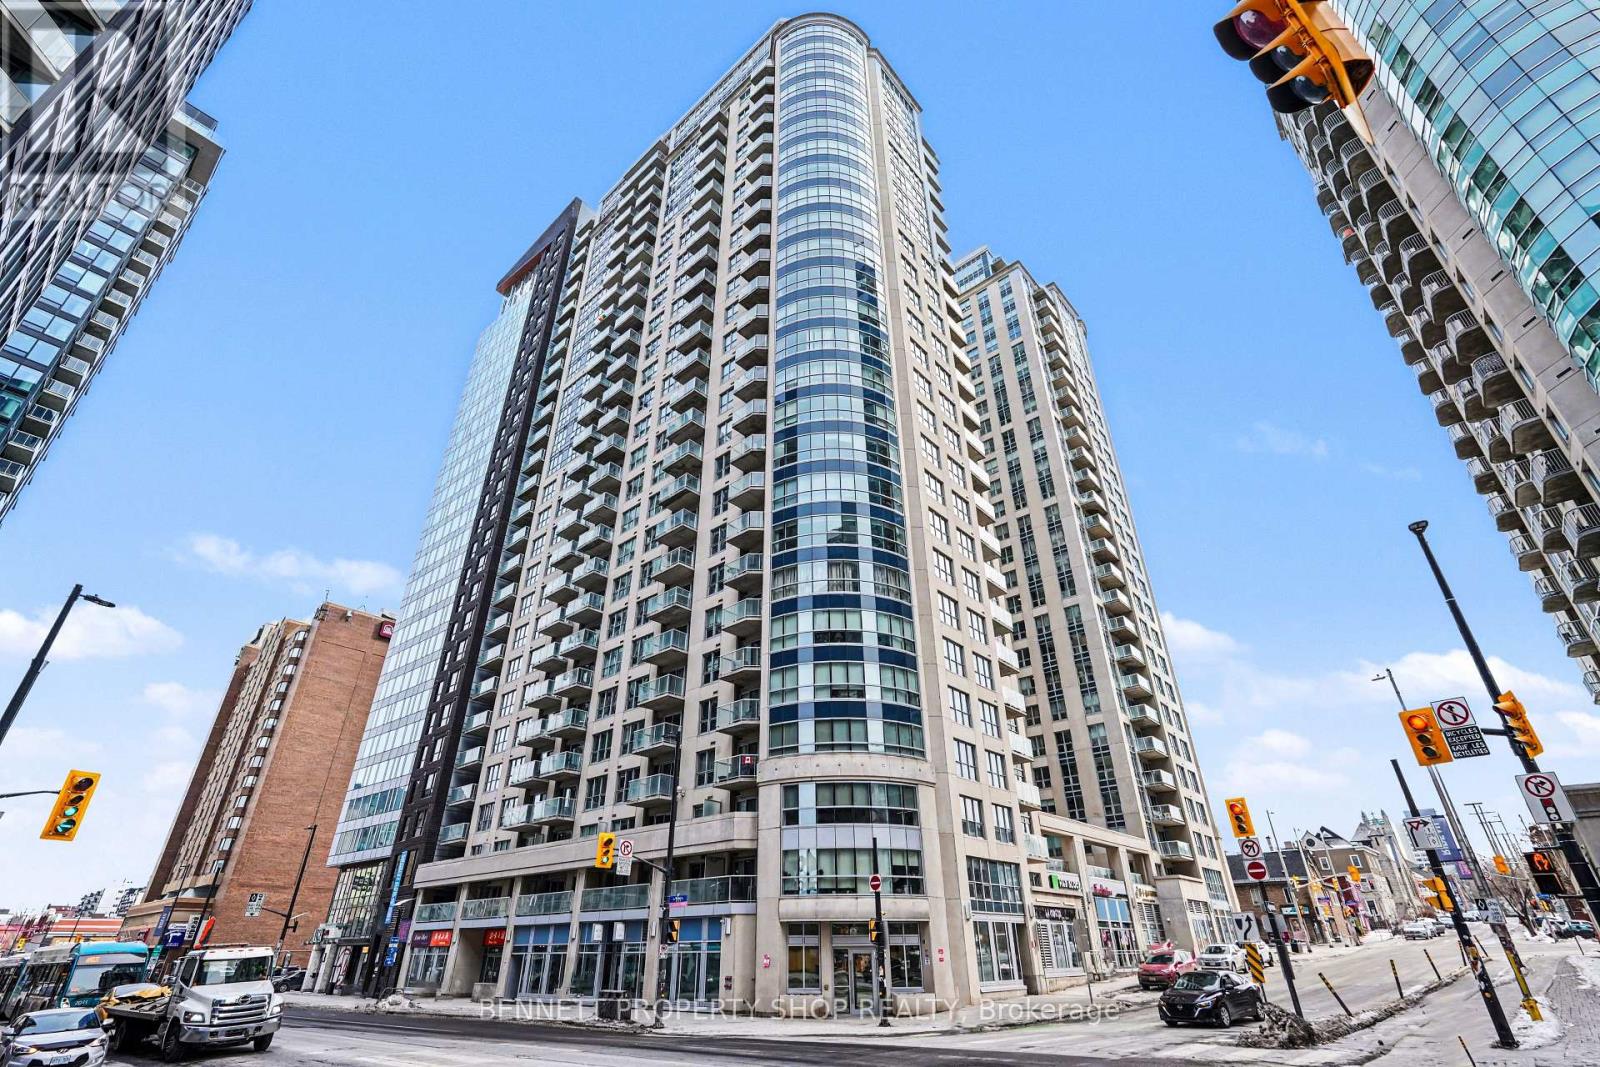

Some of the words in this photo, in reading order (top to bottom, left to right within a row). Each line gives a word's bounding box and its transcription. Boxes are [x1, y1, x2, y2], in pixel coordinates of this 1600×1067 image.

[1445, 727, 1478, 737] BICYCLES
[1447, 733, 1481, 743] EXCEPTED
[1451, 744, 1468, 752] SAUF
